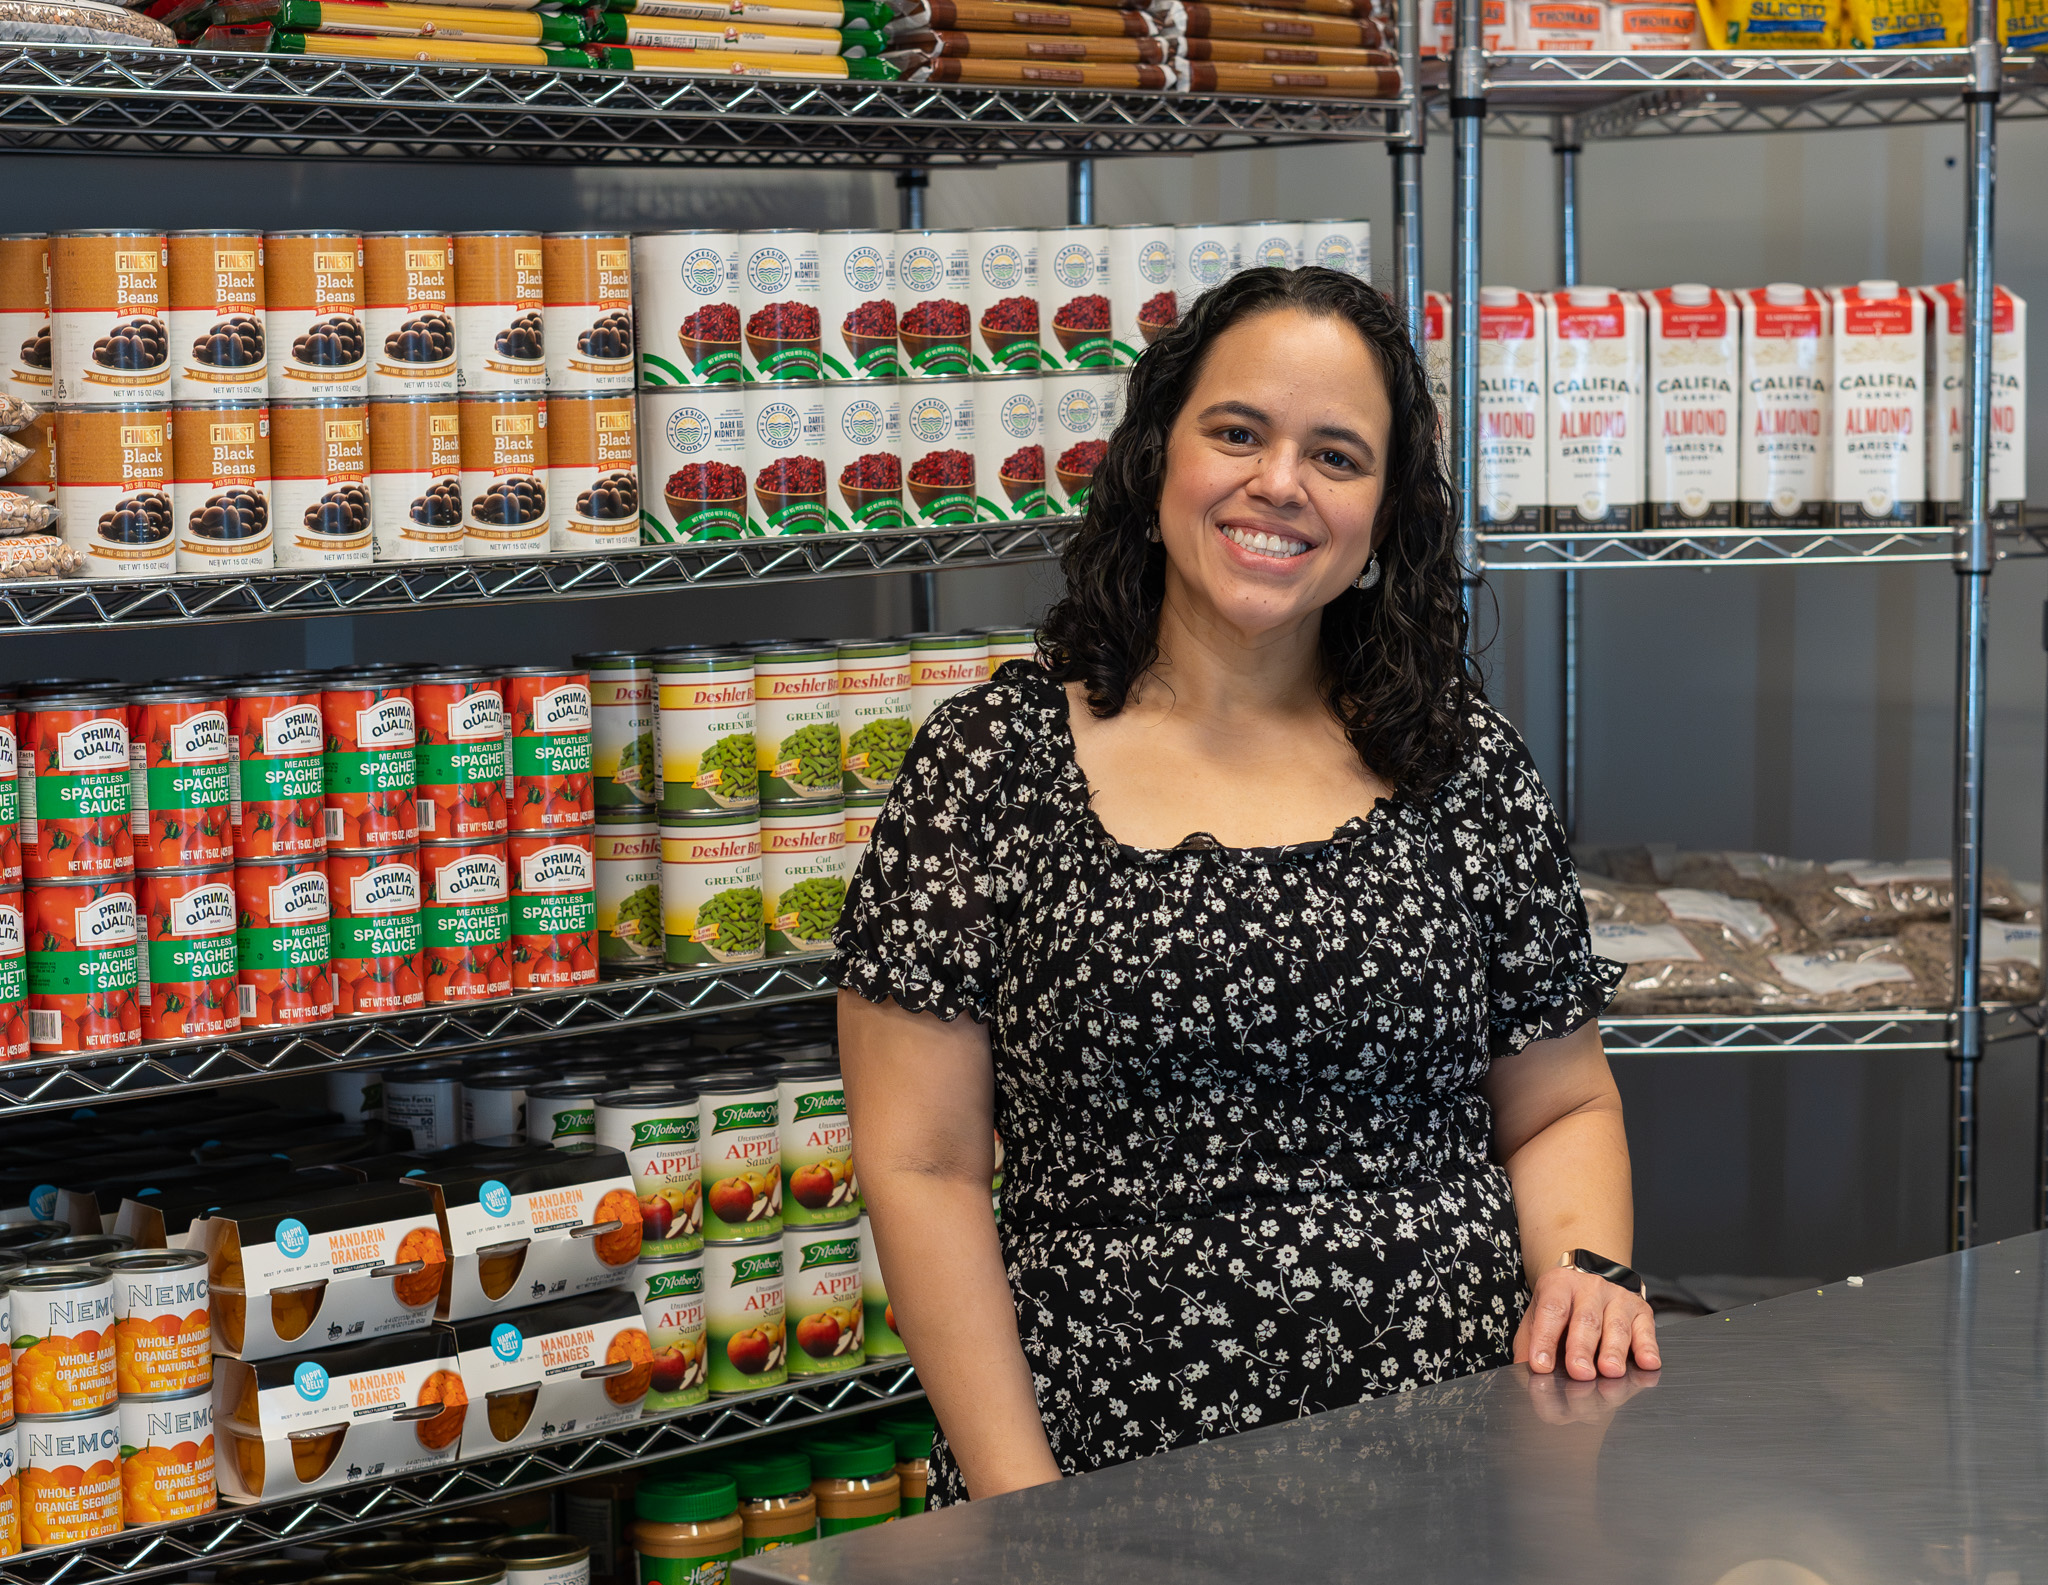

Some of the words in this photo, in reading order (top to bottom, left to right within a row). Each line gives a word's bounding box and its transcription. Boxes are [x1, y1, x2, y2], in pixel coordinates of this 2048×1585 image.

[1751, 1, 1826, 18] SLICED
[1871, 12, 1943, 31] SLICED
[119, 254, 155, 270] FINEST
[218, 254, 252, 269] FINEST
[409, 254, 443, 267] FINEST
[600, 253, 627, 266] FINEST
[687, 250, 720, 266] LAKESIDE
[752, 250, 787, 265] LAKESIDE
[118, 274, 157, 289] Black
[218, 274, 254, 288] Black
[408, 272, 444, 285] Black
[600, 272, 628, 284] Black
[408, 287, 445, 300] Beans
[599, 286, 629, 298] Beans
[690, 284, 718, 293] FOODS
[757, 282, 784, 291] FOODS
[118, 290, 158, 304] Beans
[217, 289, 256, 302] Beans
[1554, 377, 1629, 394] CALIFIA
[1657, 376, 1731, 393] CALIFIA
[1840, 373, 1917, 390] CALIFIA
[671, 409, 706, 423] LAKESIDE
[761, 405, 796, 419] LAKESIDE
[495, 419, 531, 432] FINEST
[720, 421, 735, 429] DARK
[1560, 411, 1626, 438] ALMOND
[1663, 410, 1726, 437] ALMOND
[1846, 407, 1911, 435] ALMOND
[124, 429, 161, 443] FINEST
[213, 427, 252, 442] FINEST
[329, 424, 361, 438] FINEST
[714, 430, 735, 438] KIDNEY
[495, 436, 532, 450] Black
[676, 443, 702, 452] FOODS
[767, 438, 793, 446] FOODS
[1665, 443, 1723, 454] BARISTA
[1848, 442, 1908, 453] BARISTA
[124, 449, 161, 462] Black
[214, 446, 254, 460] Black
[328, 443, 362, 457] Black
[494, 451, 534, 463] Beans
[1563, 446, 1622, 457] BARISTA
[123, 464, 163, 477] Beans
[212, 461, 255, 474] Beans
[327, 458, 363, 471] Beans
[13, 548, 32, 560] 454
[34, 549, 45, 558] G
[773, 679, 826, 694] Deshler
[842, 673, 894, 689] Deshler
[554, 692, 587, 706] PRIMA
[816, 702, 830, 710] Cut
[885, 697, 899, 705] Cut
[787, 712, 823, 721] GREEN
[855, 706, 892, 716] GREEN
[82, 729, 120, 743] PRIMA
[554, 736, 588, 745] MEATLESS
[552, 758, 590, 771] SAUCE
[81, 774, 123, 785] MEATLESS
[60, 782, 130, 800] SPAGHETT
[80, 800, 126, 814] SAUCE
[772, 833, 827, 849] Deshler
[692, 842, 746, 858] Deshler
[542, 853, 582, 866] PRIMA
[816, 856, 831, 864] Cut
[458, 862, 496, 877] PRIMA
[736, 865, 750, 874] Cut
[785, 866, 823, 875] GREEN
[705, 876, 743, 886] GREEN
[194, 892, 229, 908] PRIMA
[541, 896, 583, 905] MEATLESS
[456, 906, 498, 916] MEATLESS
[522, 904, 594, 919] SPAGHETTI
[438, 913, 508, 930] SPAGHETTI
[539, 918, 585, 930] SAUCE
[455, 930, 501, 942] SAUCE
[193, 938, 232, 949] MEATLESS
[192, 963, 234, 978] SAUCE
[529, 974, 539, 982] NET
[553, 973, 560, 982] 15
[725, 1137, 779, 1160] APPLE
[644, 1154, 700, 1176] APPLE
[746, 1156, 773, 1168] Sauce
[665, 1172, 692, 1184] Sauce
[486, 1187, 504, 1200] HAPPY
[529, 1189, 584, 1211] MANDARIN
[491, 1196, 508, 1208] BELLY
[532, 1205, 578, 1225] ORANGES
[282, 1226, 303, 1242] HAPPY
[329, 1228, 385, 1250] MANDARIN
[286, 1236, 304, 1247] BELLY
[332, 1245, 380, 1265] ORANGES
[137, 1334, 175, 1348] WHOLE
[497, 1330, 516, 1346] HAPPY
[541, 1330, 595, 1352] MANDARIN
[502, 1340, 518, 1351] BELLY
[134, 1350, 178, 1362] ORANGE
[543, 1346, 589, 1368] ORANGES
[147, 1366, 155, 1374] in
[158, 1361, 196, 1373] NATURAL
[301, 1369, 321, 1384] HAPPY
[349, 1371, 406, 1392] MANDARIN
[306, 1379, 324, 1391] BELLY
[352, 1387, 401, 1408] ORANGES
[38, 1488, 76, 1498] WHOLE
[79, 1477, 120, 1496] MANDARIN
[36, 1502, 79, 1513] ORANGE
[83, 1491, 122, 1509] SEGMENTS
[47, 1517, 56, 1525] in
[59, 1512, 99, 1525] NATURAL
[101, 1507, 119, 1519] JUICE
[51, 1532, 65, 1540] NET
[81, 1529, 88, 1537] 11
[91, 1529, 99, 1537] OZ
